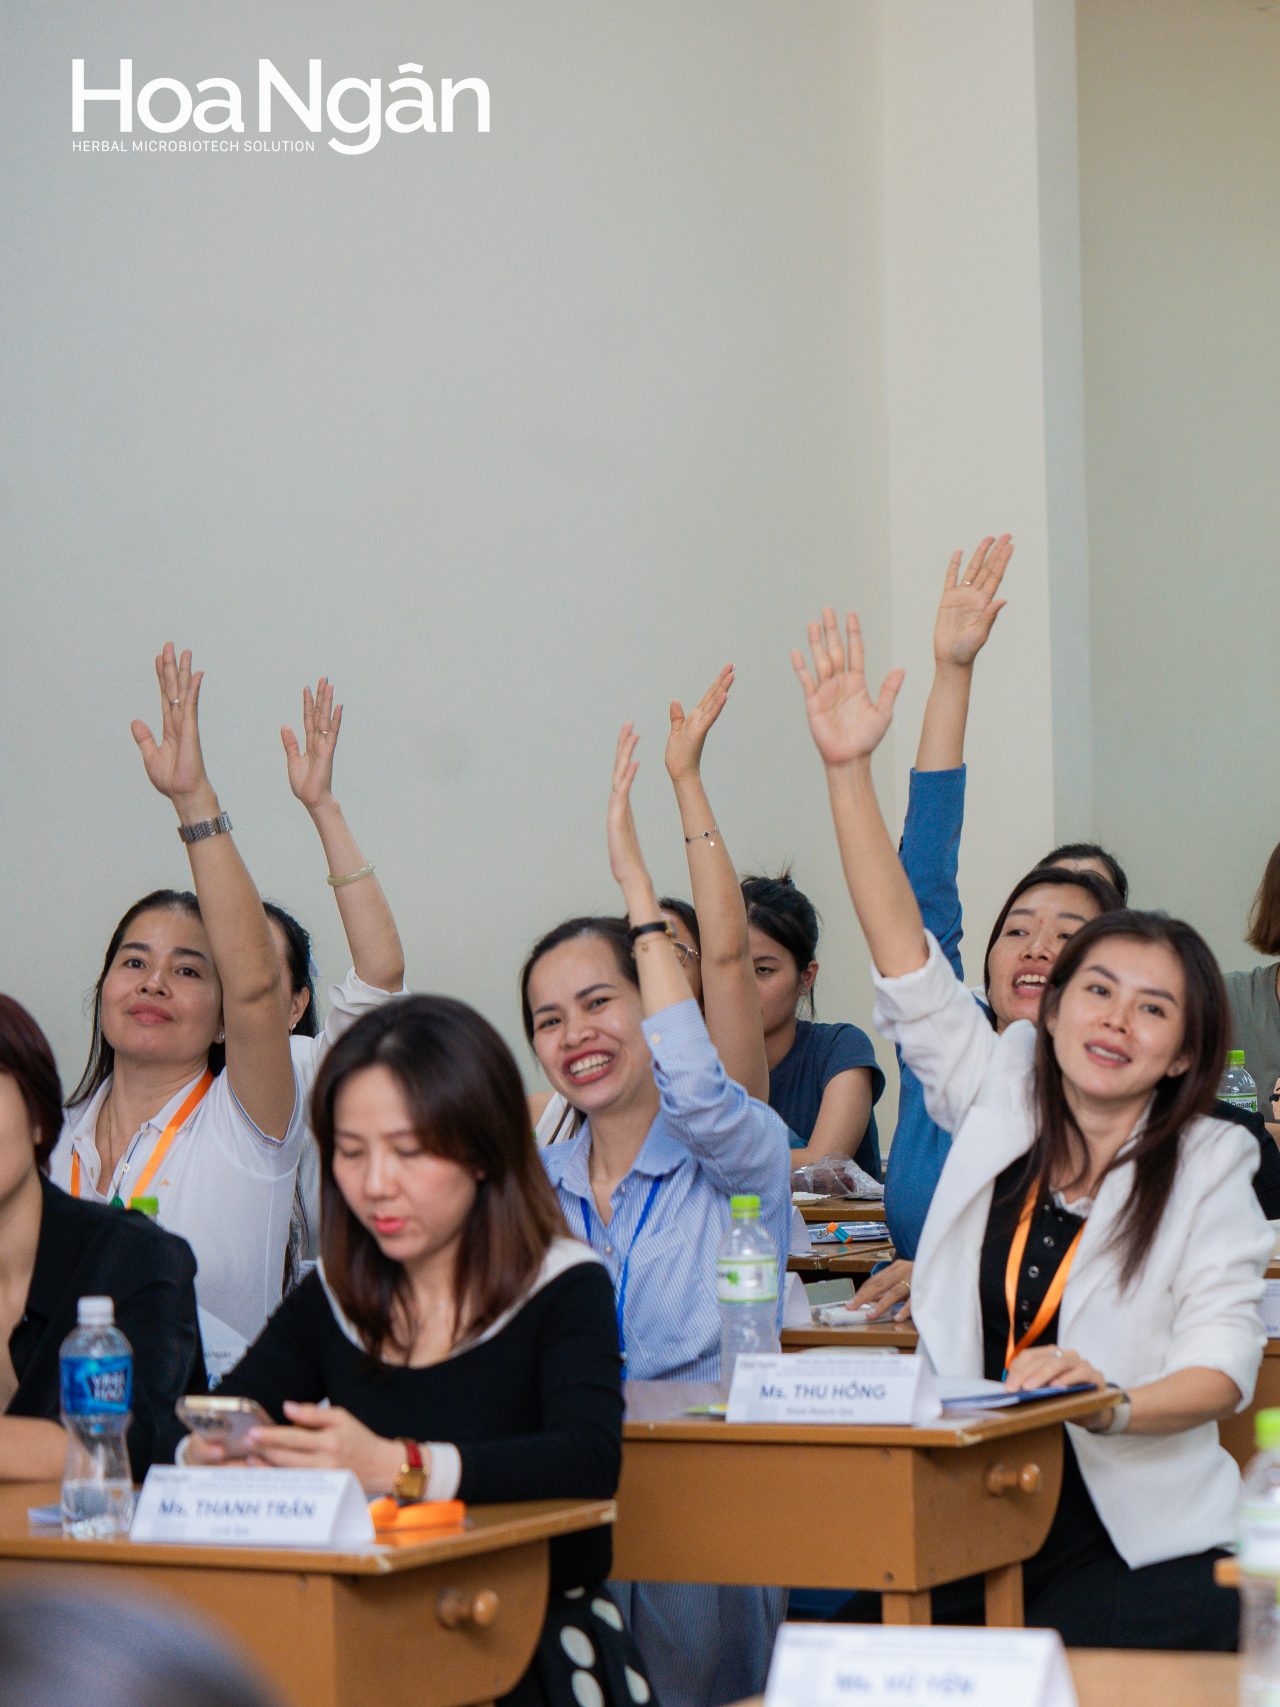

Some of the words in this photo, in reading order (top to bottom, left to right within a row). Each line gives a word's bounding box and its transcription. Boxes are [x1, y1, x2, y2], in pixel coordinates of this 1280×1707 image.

[759, 1384, 788, 1398] Ms.
[794, 1383, 829, 1399] THU
[196, 1498, 261, 1517] THANH
